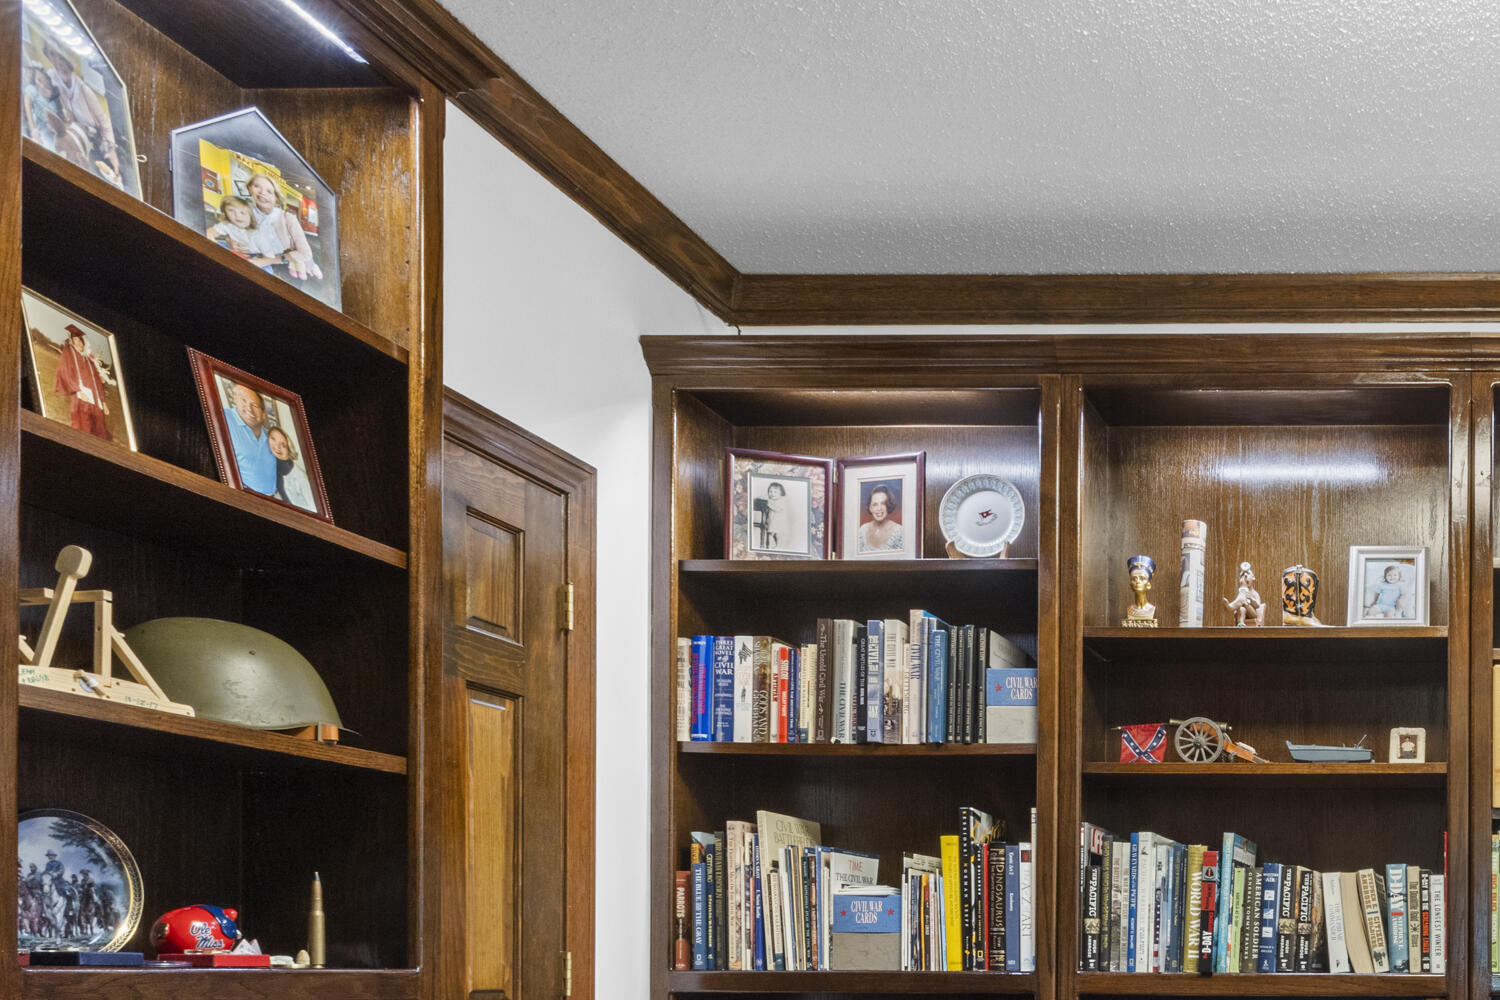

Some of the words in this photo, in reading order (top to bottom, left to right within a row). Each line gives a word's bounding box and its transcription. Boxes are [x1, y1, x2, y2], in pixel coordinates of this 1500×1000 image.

[911, 644, 920, 662] CIVIL
[911, 664, 920, 679] WAR
[759, 690, 767, 715] GODS
[1010, 688, 1032, 700] CARDS
[759, 717, 767, 734] AND
[995, 865, 1004, 927] DINOSAURUS
[1088, 880, 1097, 917] PACIFIC
[1189, 871, 1202, 916] WORLD
[1254, 873, 1262, 920] AMERICAN
[1283, 881, 1291, 917] PACIFIC
[1361, 874, 1371, 910] AMBROSE
[1367, 873, 1376, 902] STEPHEN
[1390, 868, 1404, 912] D-DAY
[1410, 882, 1418, 890] The
[676, 887, 684, 918] PARROTS
[851, 900, 868, 912] CIVIL
[870, 900, 883, 912] WAR
[1300, 886, 1309, 922] PACIFIC
[1410, 891, 1419, 910] Doolittle
[190, 921, 210, 936] Ole
[856, 911, 878, 924] CARDS
[1410, 911, 1419, 921] Raid
[195, 935, 224, 949] Miss
[1188, 919, 1202, 947] WAR
[1201, 931, 1212, 953] D-DAY
[1252, 922, 1260, 959] SOLDIER
[1368, 918, 1377, 949] SOLDIERS
[1373, 916, 1384, 947] CITIZEN
[1188, 950, 1202, 959] II
